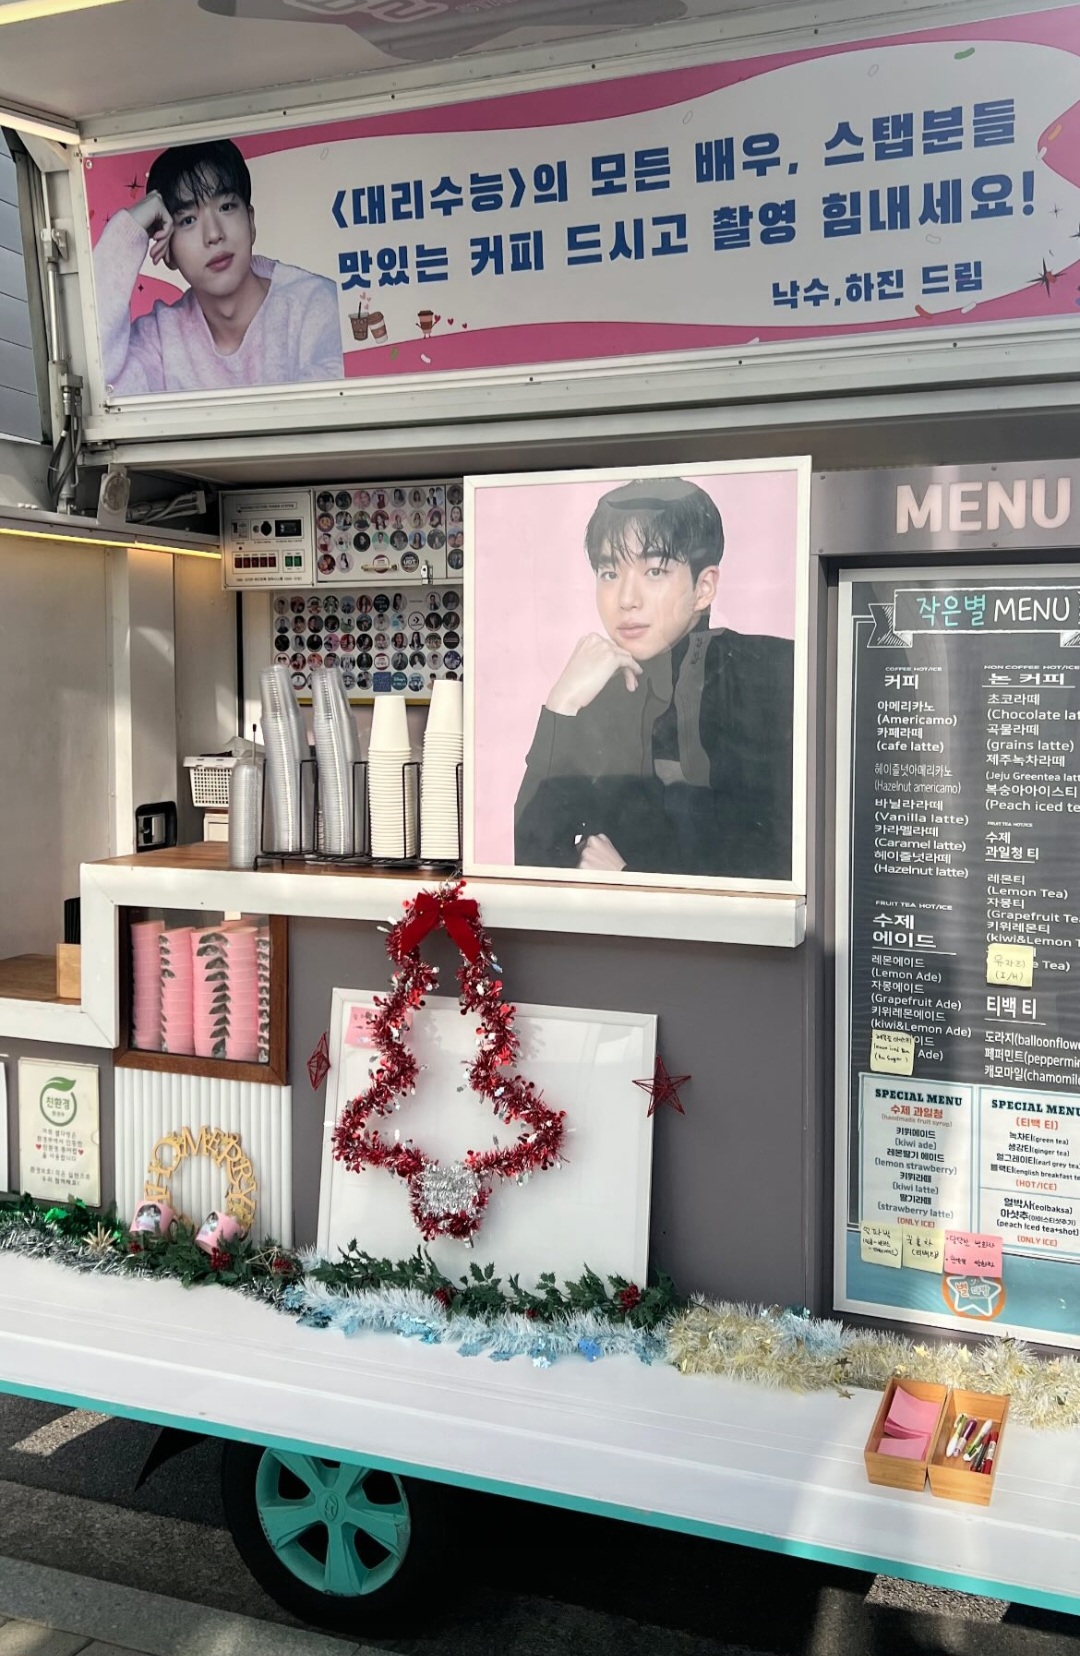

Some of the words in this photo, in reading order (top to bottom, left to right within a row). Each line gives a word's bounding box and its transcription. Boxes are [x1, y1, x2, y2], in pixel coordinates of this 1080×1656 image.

[591, 144, 671, 194] 모든
[694, 130, 800, 183] 배우,
[823, 97, 1018, 168] 스탭분들
[336, 243, 450, 292] 맛있는
[468, 229, 545, 279] 커피
[565, 212, 689, 267] 드시고
[712, 196, 797, 252] 촬영
[820, 169, 1038, 244] 힘내세요!
[771, 269, 905, 311] 낙수,하진
[921, 259, 984, 297] 드림
[896, 478, 1071, 534] MENU
[916, 594, 987, 627] 작은별
[993, 596, 1070, 622] MENU
[884, 674, 919, 690] 커피
[1020, 672, 1065, 686] 커피
[877, 701, 936, 713] 아메리카노
[987, 693, 1040, 706] 초코라떼
[877, 714, 958, 726] (Americamo)
[987, 708, 1062, 721] (Chocolate
[877, 727, 924, 740] 카페라떼
[987, 723, 1040, 736] 곡물라떼
[876, 740, 908, 753] (cafe
[910, 741, 945, 754] latte)
[987, 738, 1035, 752] (grains
[1037, 739, 1075, 753] latte)
[986, 753, 1066, 767] 제주녹차라떼
[874, 763, 954, 778] 헤이즐넛아메리카노
[985, 771, 1011, 782] (Jeju
[1012, 772, 1062, 782] Greentea
[874, 779, 912, 793] (Hazelnut
[986, 783, 1079, 798] 복숭아아이스티
[874, 798, 944, 811] 바닐라라떼
[985, 798, 1032, 811] (Peach
[1034, 801, 1064, 813] iced
[874, 811, 927, 823] (Vanilla
[930, 813, 969, 825] latte)
[874, 825, 940, 838] 카라멜라떼
[985, 831, 1011, 844] 수제
[874, 838, 931, 850] (Caramel
[933, 840, 967, 853] latte)
[985, 846, 1023, 860] 과일청
[1026, 847, 1040, 860] 티
[874, 851, 952, 864] 헤이즐넛라떼
[874, 863, 934, 876] (Hazelnut
[935, 866, 970, 879] latte)
[987, 873, 1026, 886] 레몬티
[987, 885, 1037, 897] (Lemon
[1040, 888, 1069, 901] Tea)
[919, 903, 953, 911] HOT/ICE
[987, 897, 1026, 910] 자몽티
[872, 913, 915, 930] 수제
[986, 908, 1060, 923] (Grapefruit
[987, 920, 1051, 935] 키위레몬티
[872, 931, 937, 949] 에이드
[986, 932, 1072, 948] (kiwi&Lemon
[871, 954, 926, 969] 레몬에이드
[1042, 961, 1071, 972] Tea)
[871, 967, 913, 981] (Lemon
[915, 972, 942, 985] Ade)
[871, 981, 925, 994] 자몽에이드
[871, 993, 933, 1008] (Grapefruit
[935, 999, 962, 1012] Ade)
[986, 995, 1017, 1019] 티백
[1021, 998, 1037, 1020] 티
[871, 1006, 947, 1021] 키위레몬에이드
[870, 1018, 943, 1034] (kiwi&Lemon
[945, 1025, 972, 1039] Ade)
[917, 1051, 945, 1064] Ade)
[44, 1095, 71, 1112] 친환경
[875, 1088, 925, 1103] SPECIAL
[926, 1093, 963, 1107] MENU
[890, 1104, 911, 1116] 수제
[912, 1106, 944, 1120] 과일청
[991, 1099, 1043, 1114] SPECIAL
[1045, 1103, 1080, 1118] MENU
[881, 1113, 916, 1124] (handmade
[916, 1117, 931, 1126] fruit
[1015, 1116, 1041, 1130] (티백
[1043, 1119, 1059, 1131] 티)
[896, 1126, 937, 1140] 키위에이드
[1008, 1131, 1055, 1145] 녹차티(green
[1055, 1137, 1069, 1146] tea)
[894, 1137, 917, 1149] (kiwi
[918, 1140, 938, 1151] ade)
[1007, 1142, 1056, 1158] 생강티(ginger
[1056, 1149, 1070, 1157] tea)
[886, 1147, 920, 1160] 레몬딸기
[920, 1152, 946, 1163] 에이드
[874, 1156, 905, 1168] (lemon
[905, 1160, 958, 1177] strawberry)
[1051, 1159, 1067, 1170] grey
[899, 1171, 933, 1184] 키위라떼
[1040, 1169, 1073, 1181] breakfast
[892, 1181, 914, 1192] (kiwi
[915, 1183, 939, 1195] latte)
[1015, 1178, 1058, 1192] (HOT/ICE)
[899, 1193, 933, 1206] 딸기라떼
[877, 1200, 929, 1217] (strawberry
[929, 1207, 954, 1220] latte)
[896, 1216, 919, 1228] (ONLY
[919, 1218, 936, 1229] ICE)
[996, 1219, 1023, 1231] (peach
[1041, 1225, 1080, 1237] tea+shot)
[1017, 1235, 1042, 1245] (ONLY
[1042, 1238, 1058, 1247] ICE)
[954, 1281, 970, 1298] 별
